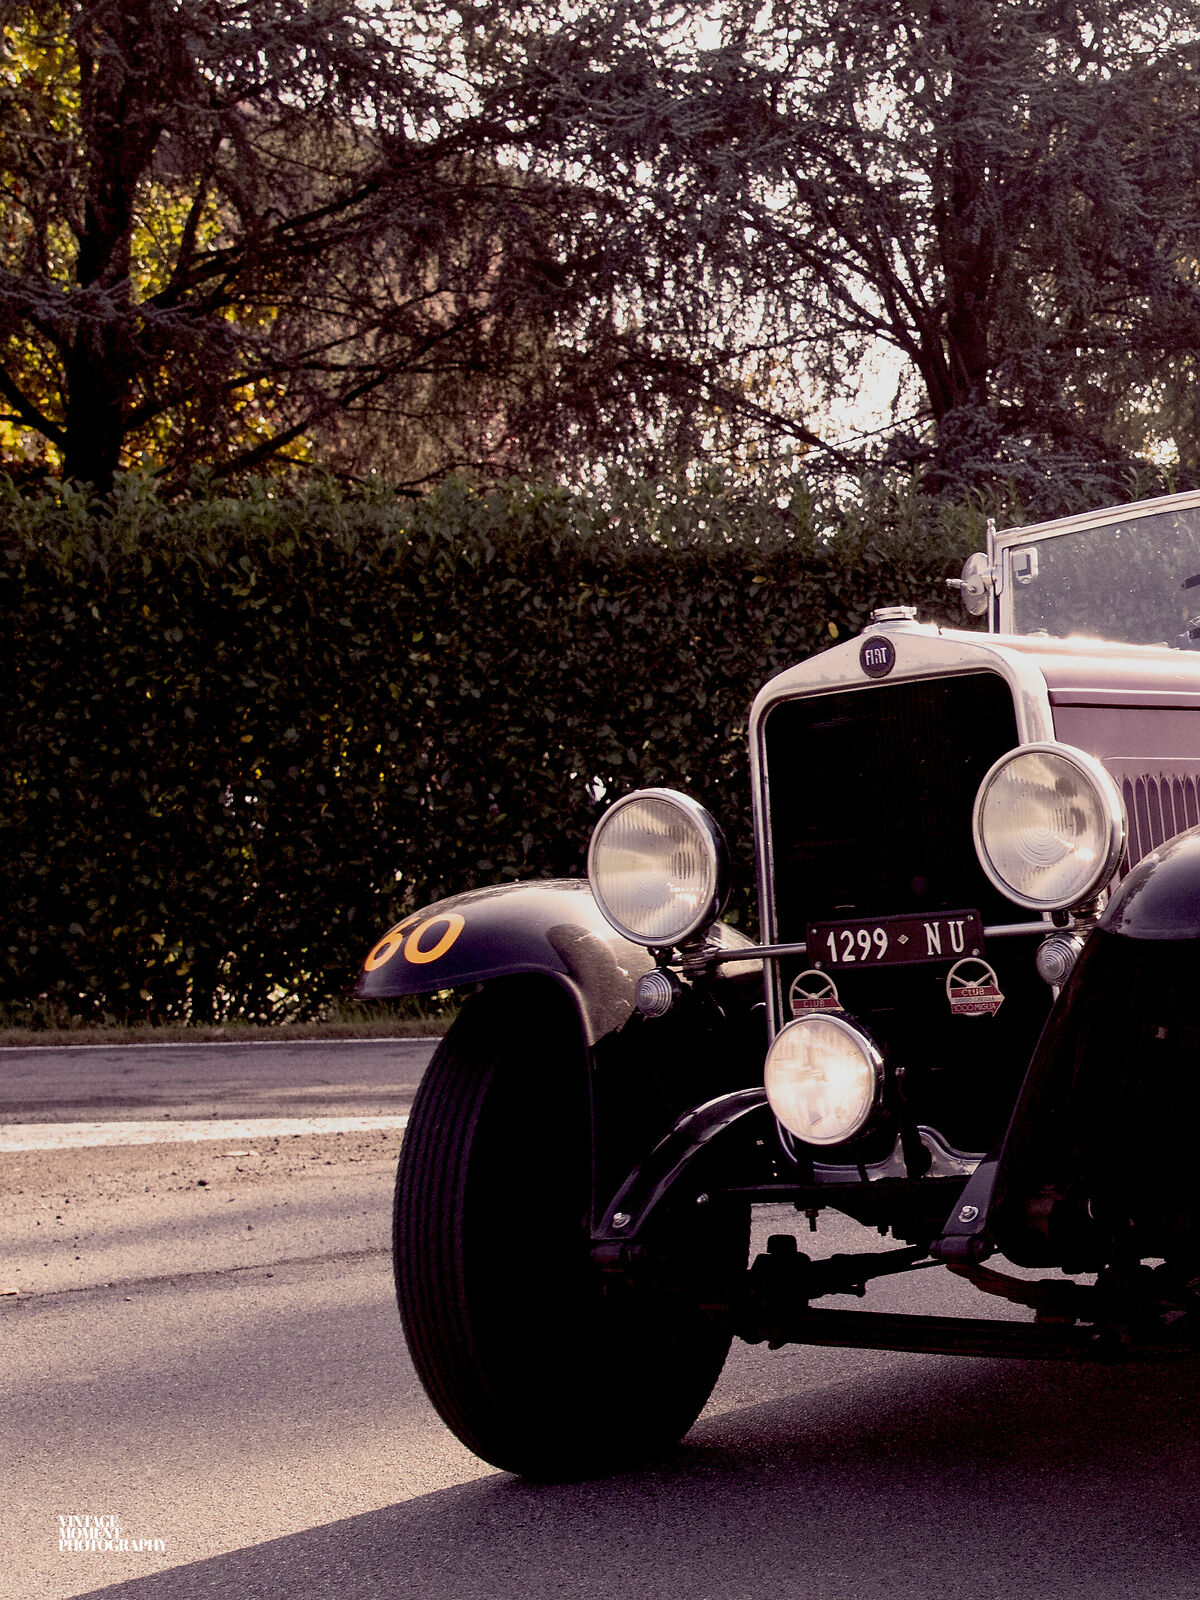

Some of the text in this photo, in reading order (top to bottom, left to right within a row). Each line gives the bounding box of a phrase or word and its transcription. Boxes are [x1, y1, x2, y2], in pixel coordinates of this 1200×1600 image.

[865, 647, 887, 665] FIAT
[365, 914, 465, 972] 60
[826, 928, 888, 962] 1299
[961, 988, 985, 996] CLUB
[803, 1000, 825, 1008] CLUB
[974, 1003, 997, 1011] MIGLIA
